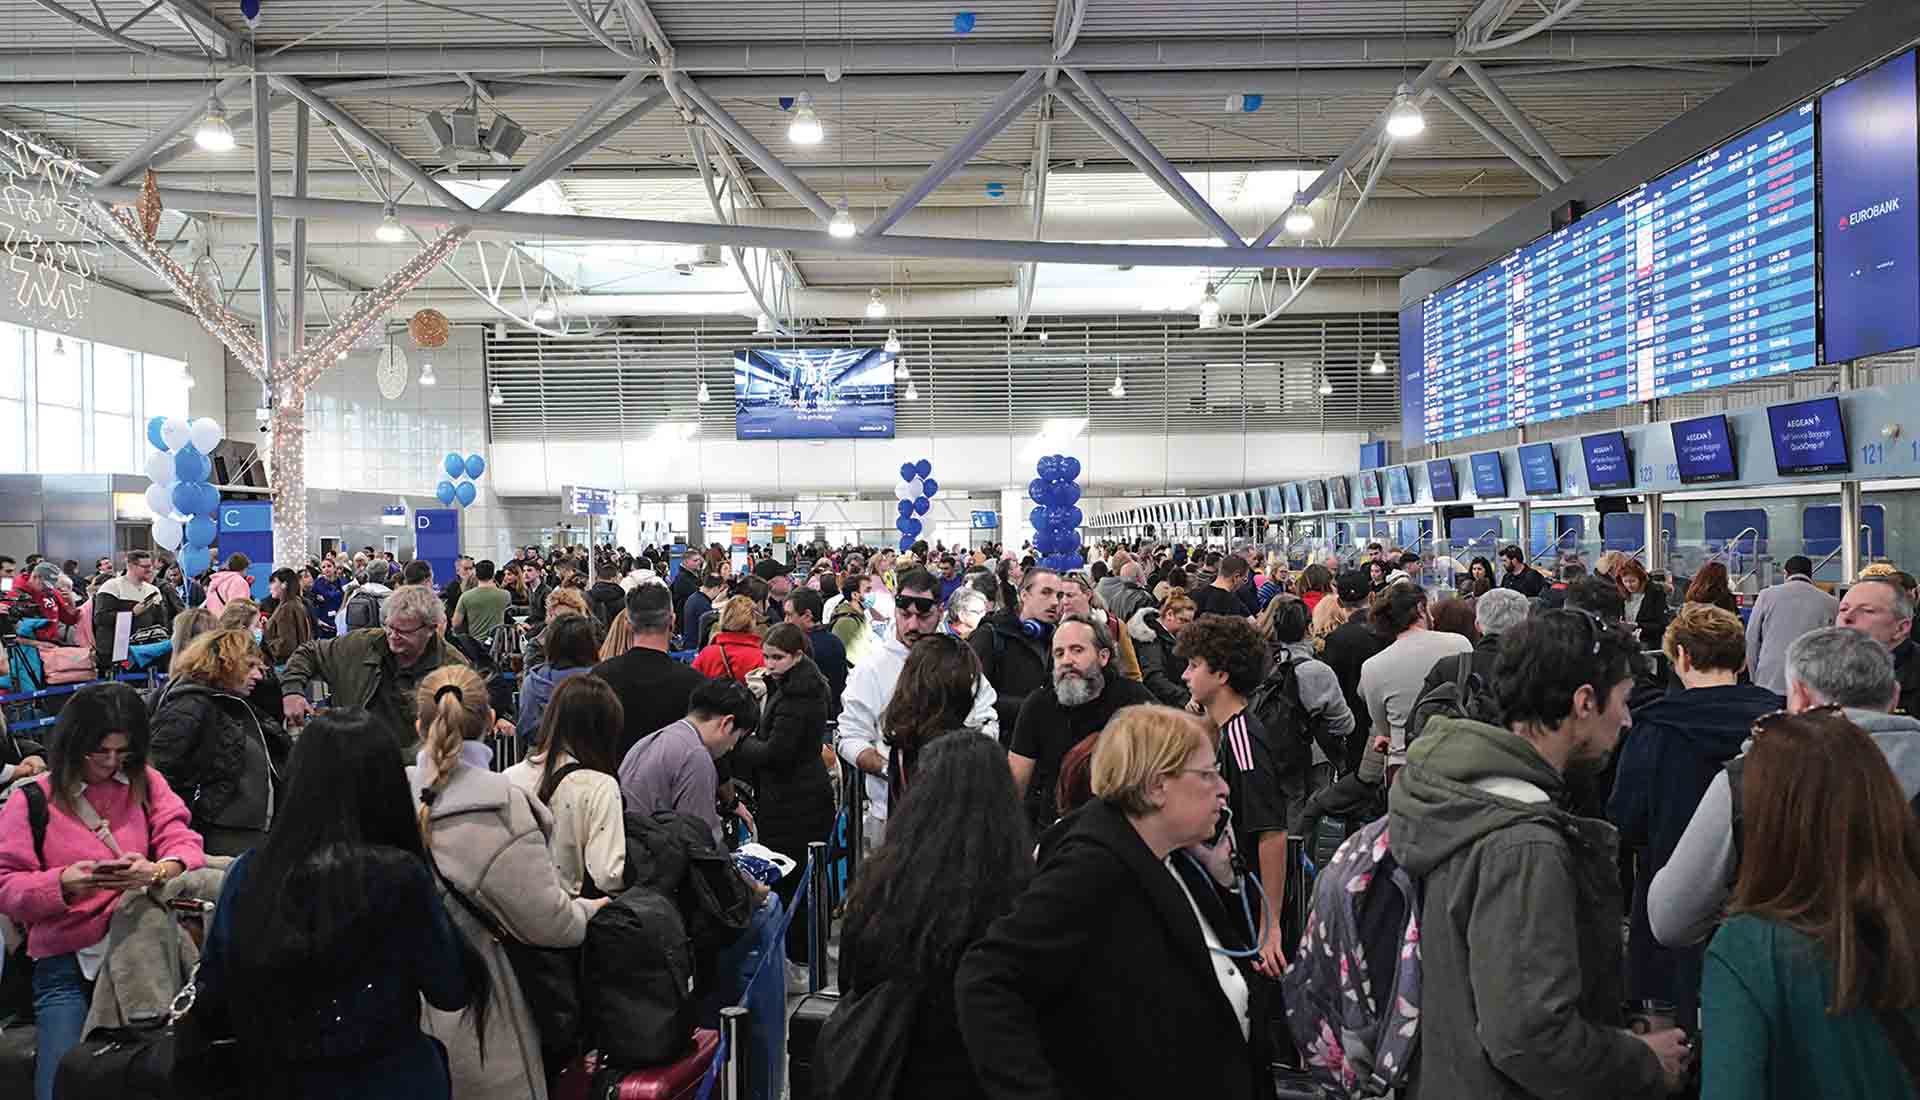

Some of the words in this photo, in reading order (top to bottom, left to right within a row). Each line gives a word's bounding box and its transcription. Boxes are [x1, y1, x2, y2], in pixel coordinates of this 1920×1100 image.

[1849, 197, 1900, 225] EUROBANK
[1786, 418, 1815, 428] AEGEAN
[1861, 441, 1882, 465] 121
[1640, 465, 1653, 482] 123
[224, 510, 240, 527] C
[417, 516, 430, 529] D
